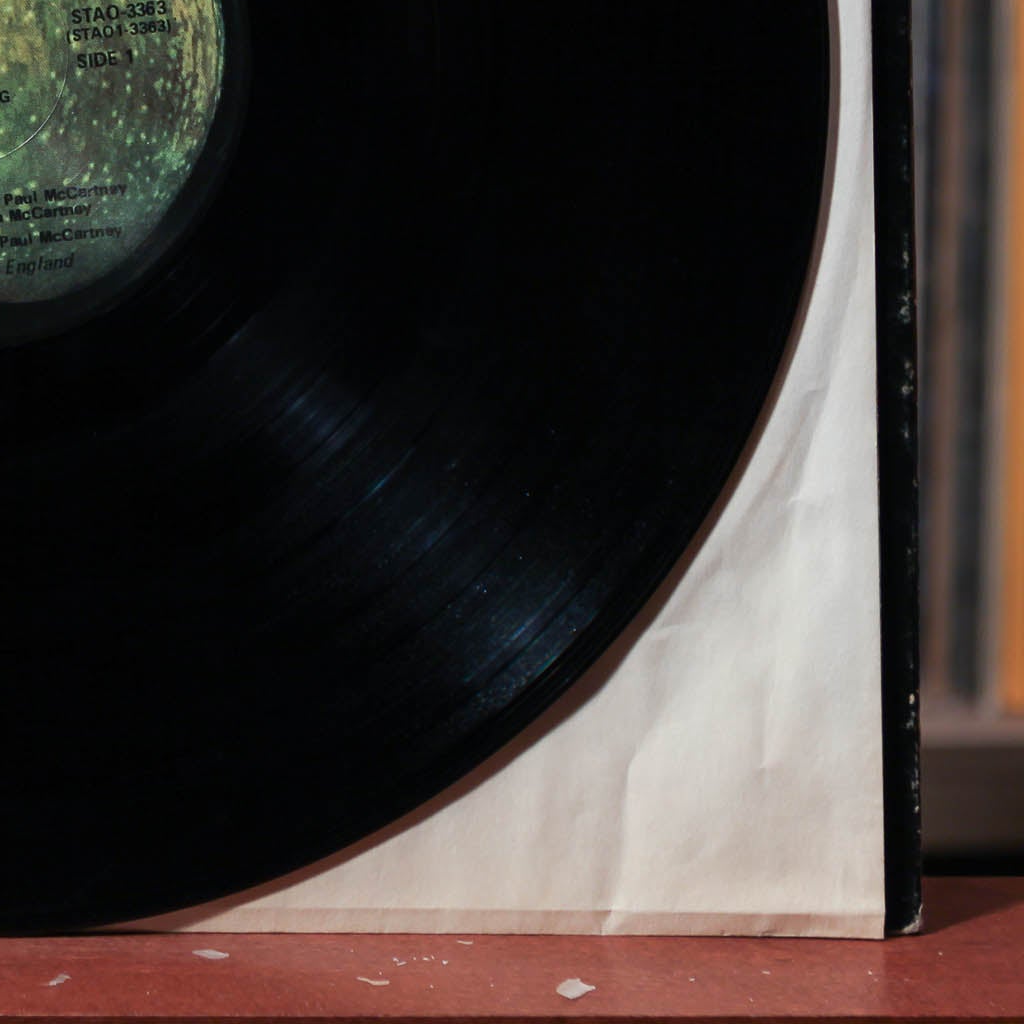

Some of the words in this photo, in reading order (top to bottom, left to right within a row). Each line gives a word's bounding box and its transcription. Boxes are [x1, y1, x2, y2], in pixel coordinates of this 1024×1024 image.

[77, 51, 118, 69] SIDE
[126, 49, 134, 64] 1
[3, 191, 38, 206] Paul
[43, 183, 128, 202] McCartney
[8, 204, 92, 223] McCartney
[0, 233, 33, 248] Paul
[39, 226, 123, 245] McCartney
[6, 253, 76, 275] England
